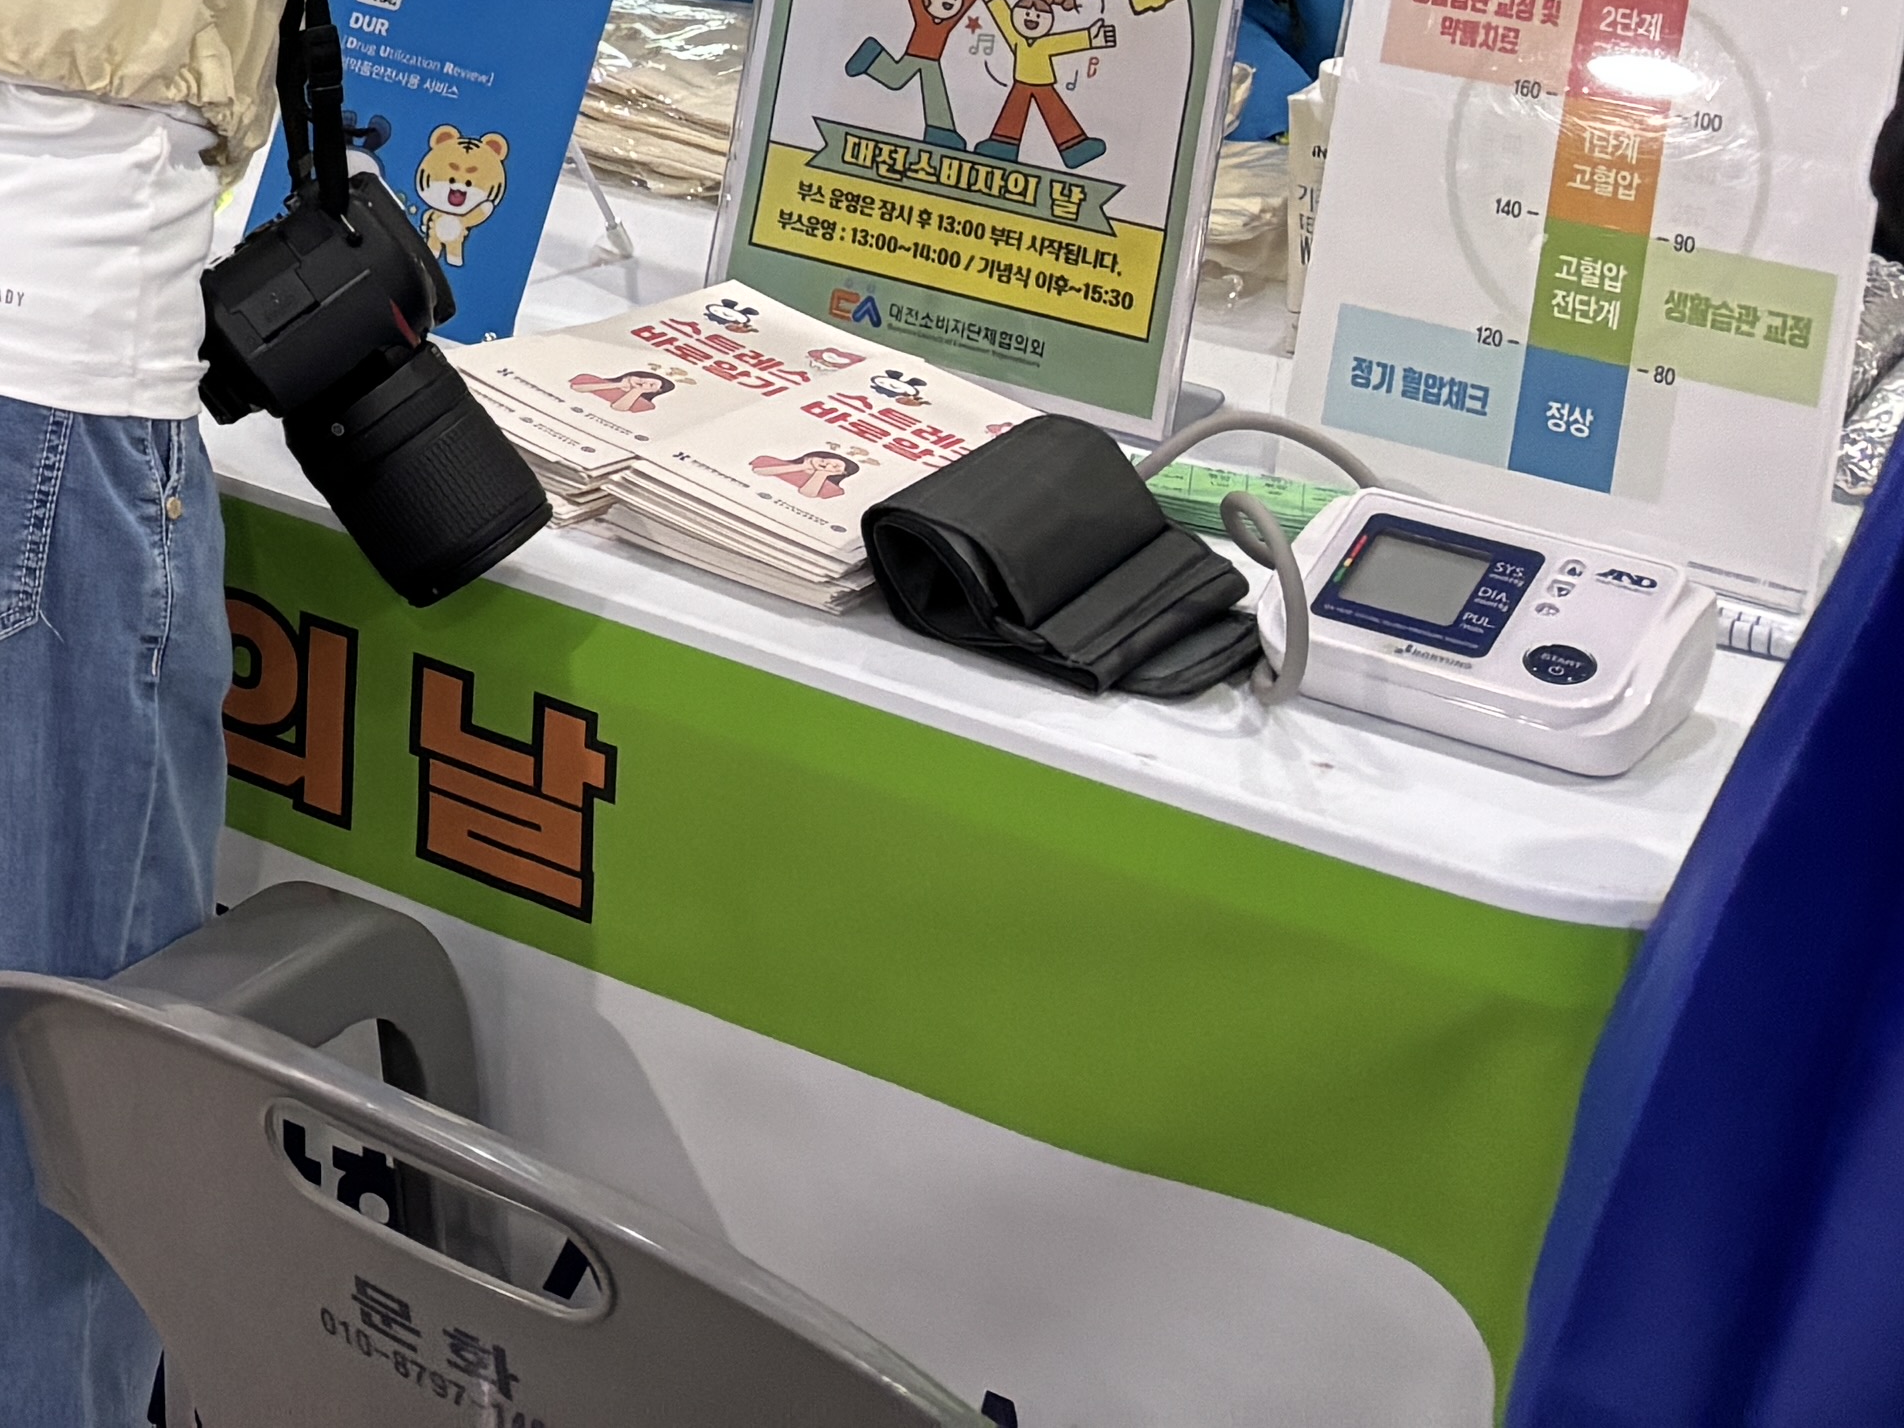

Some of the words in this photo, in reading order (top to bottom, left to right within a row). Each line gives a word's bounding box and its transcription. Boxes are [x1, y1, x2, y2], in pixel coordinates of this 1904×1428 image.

[349, 12, 390, 37] DUR
[1599, 5, 1664, 42] 2단계
[379, 44, 441, 73] Utilization
[423, 78, 459, 99] 서비스
[1514, 79, 1542, 99] 160
[1692, 110, 1723, 132] 100
[1583, 129, 1641, 165] 1단계
[842, 131, 1041, 207] 대전소비자의
[1049, 179, 1088, 223] 날
[1567, 163, 1641, 201] 고혈압
[1495, 197, 1522, 219] 140
[797, 179, 827, 205] 부스
[828, 187, 877, 219] 운영은
[878, 199, 914, 228] 잠시
[916, 209, 934, 231] 후
[936, 214, 987, 241] 13:00
[990, 224, 1024, 253] 부터
[1026, 235, 1123, 277] 시작됩니다.
[1673, 233, 1696, 253] 90
[777, 208, 837, 241] 부스운영
[850, 227, 962, 270] 13:00~14:00
[964, 254, 975, 271] /
[976, 257, 1033, 289] 기념식
[1034, 269, 1135, 311] 이후~15:30
[1554, 254, 1628, 294] 고혈압
[1551, 289, 1621, 331] 전단계
[1663, 289, 1761, 339] 생활습관
[1763, 308, 1813, 350] 교정
[889, 303, 1046, 358] 대전소비자단체협의회
[1475, 325, 1504, 348] 120
[630, 324, 790, 398] 바로알기
[659, 317, 812, 386] 스트레스
[1350, 355, 1395, 394] 정기
[1401, 365, 1491, 417] 혈압체크
[1653, 364, 1677, 387] 80
[1545, 400, 1594, 438] 정상
[1540, 652, 1585, 669] START
[408, 650, 619, 926] 날
